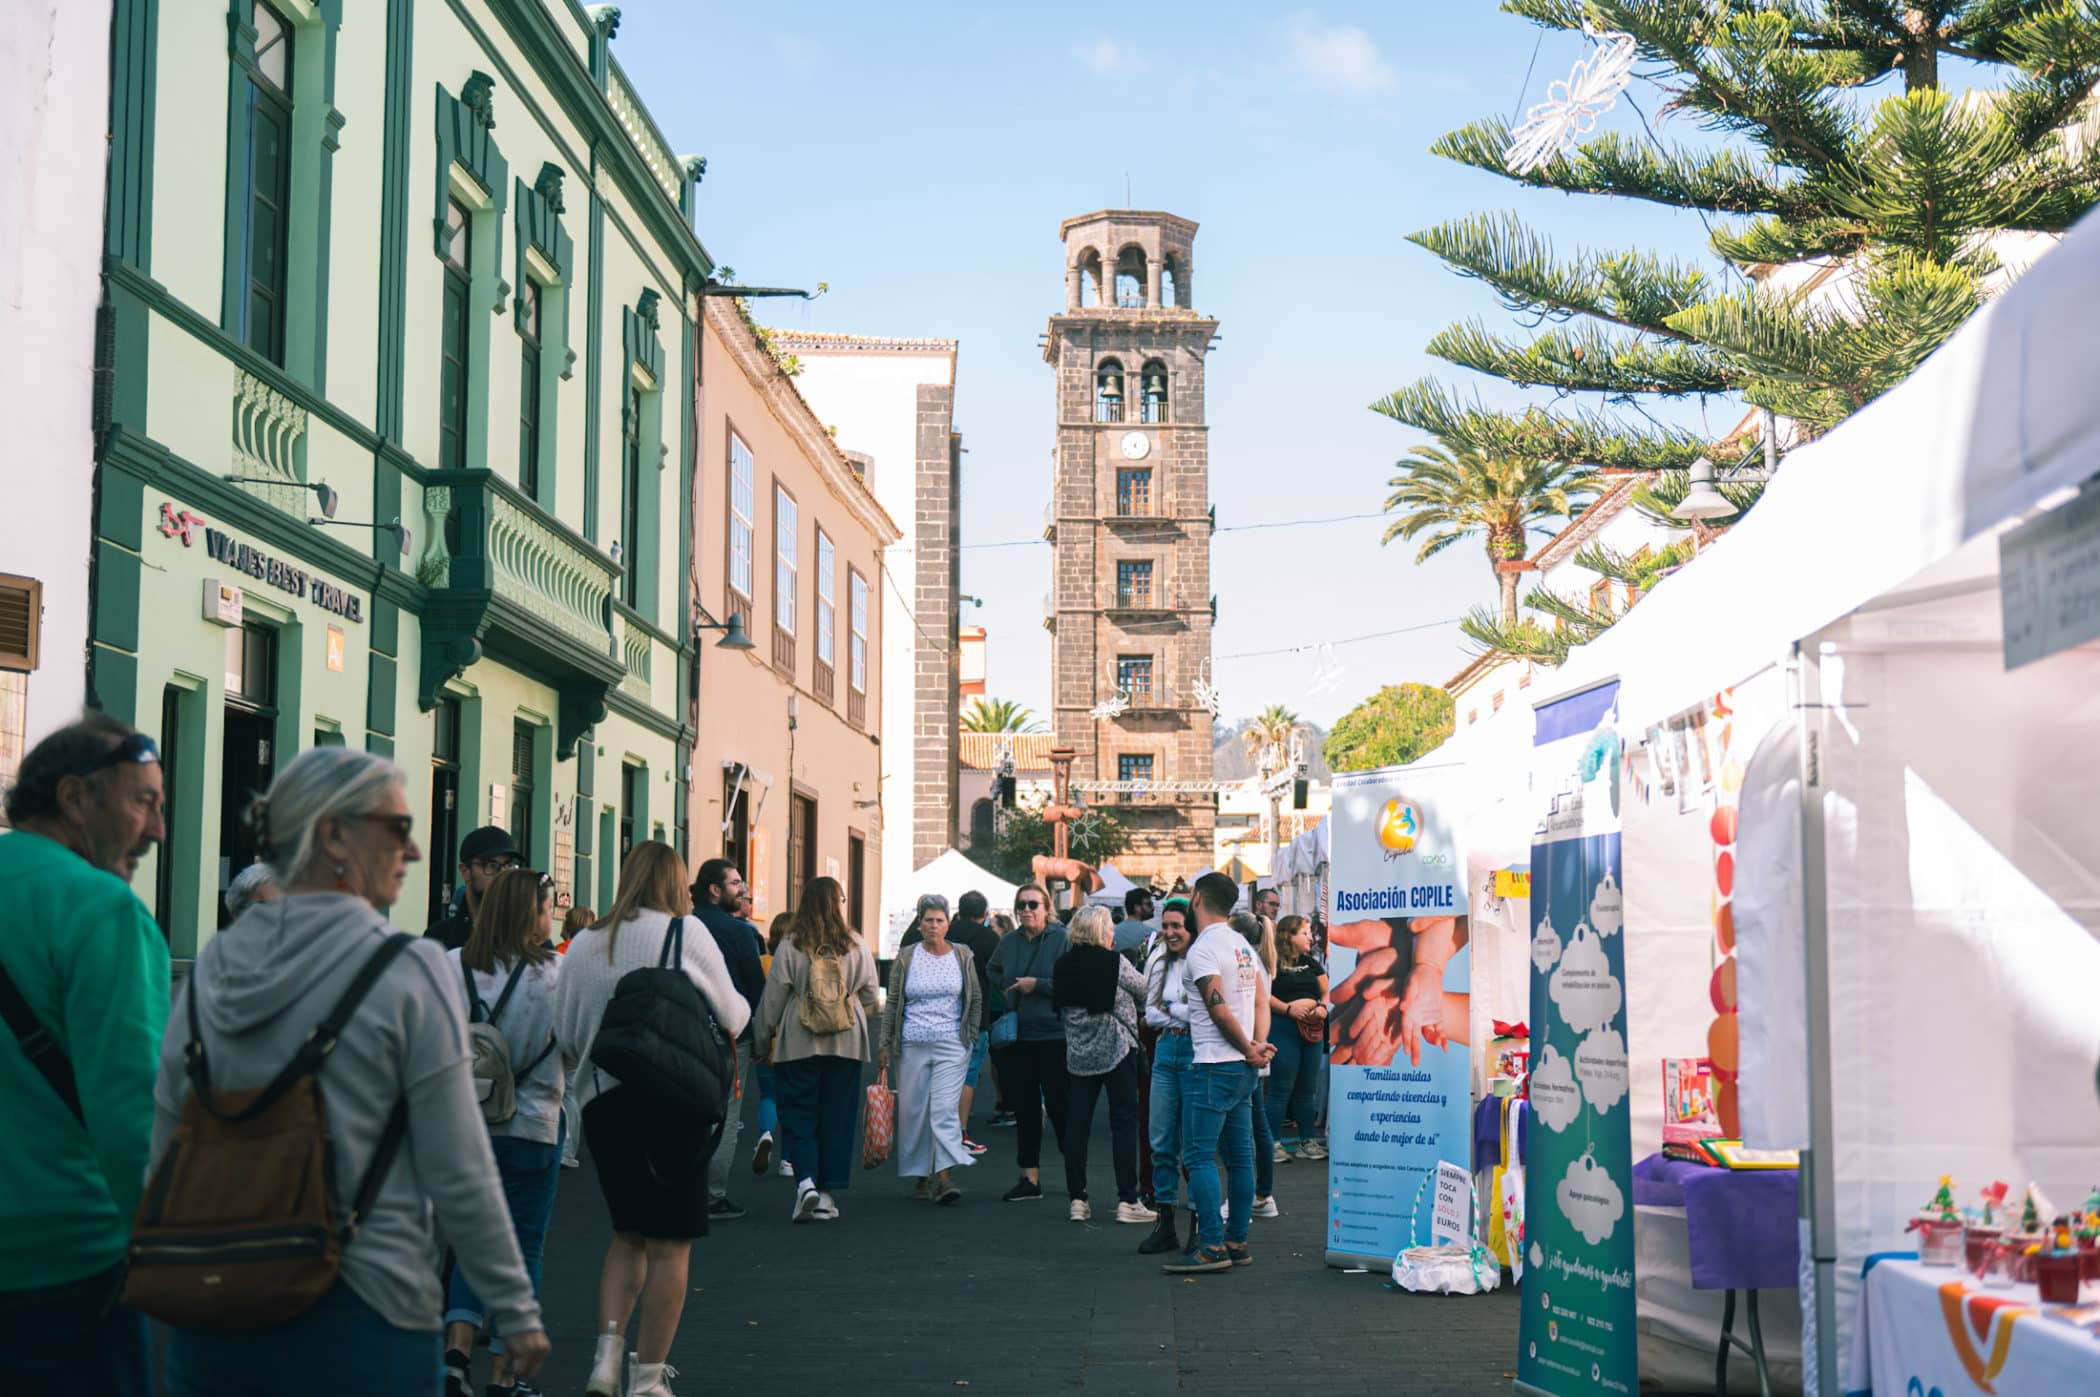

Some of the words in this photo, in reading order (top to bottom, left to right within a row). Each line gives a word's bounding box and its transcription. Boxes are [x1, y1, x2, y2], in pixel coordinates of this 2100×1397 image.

[206, 528, 266, 580] VIAJES
[267, 557, 309, 598] BEST
[312, 577, 364, 624] TRAVEL
[1337, 886, 1406, 911] Asociación
[1411, 885, 1453, 908] COPILE
[1402, 1070, 1431, 1082] unidas
[1347, 1090, 1400, 1104] compartiendo
[1402, 1092, 1440, 1104] vivencias
[1441, 1095, 1447, 1107] y
[1370, 1112, 1421, 1125] experiencias
[1354, 1130, 1380, 1142] dando
[1381, 1131, 1389, 1143] lo
[1390, 1132, 1413, 1147] mejor
[1415, 1134, 1426, 1145] de
[1440, 1181, 1456, 1192] TOCA
[1439, 1193, 1453, 1204] CON
[1437, 1216, 1460, 1232] EUROS
